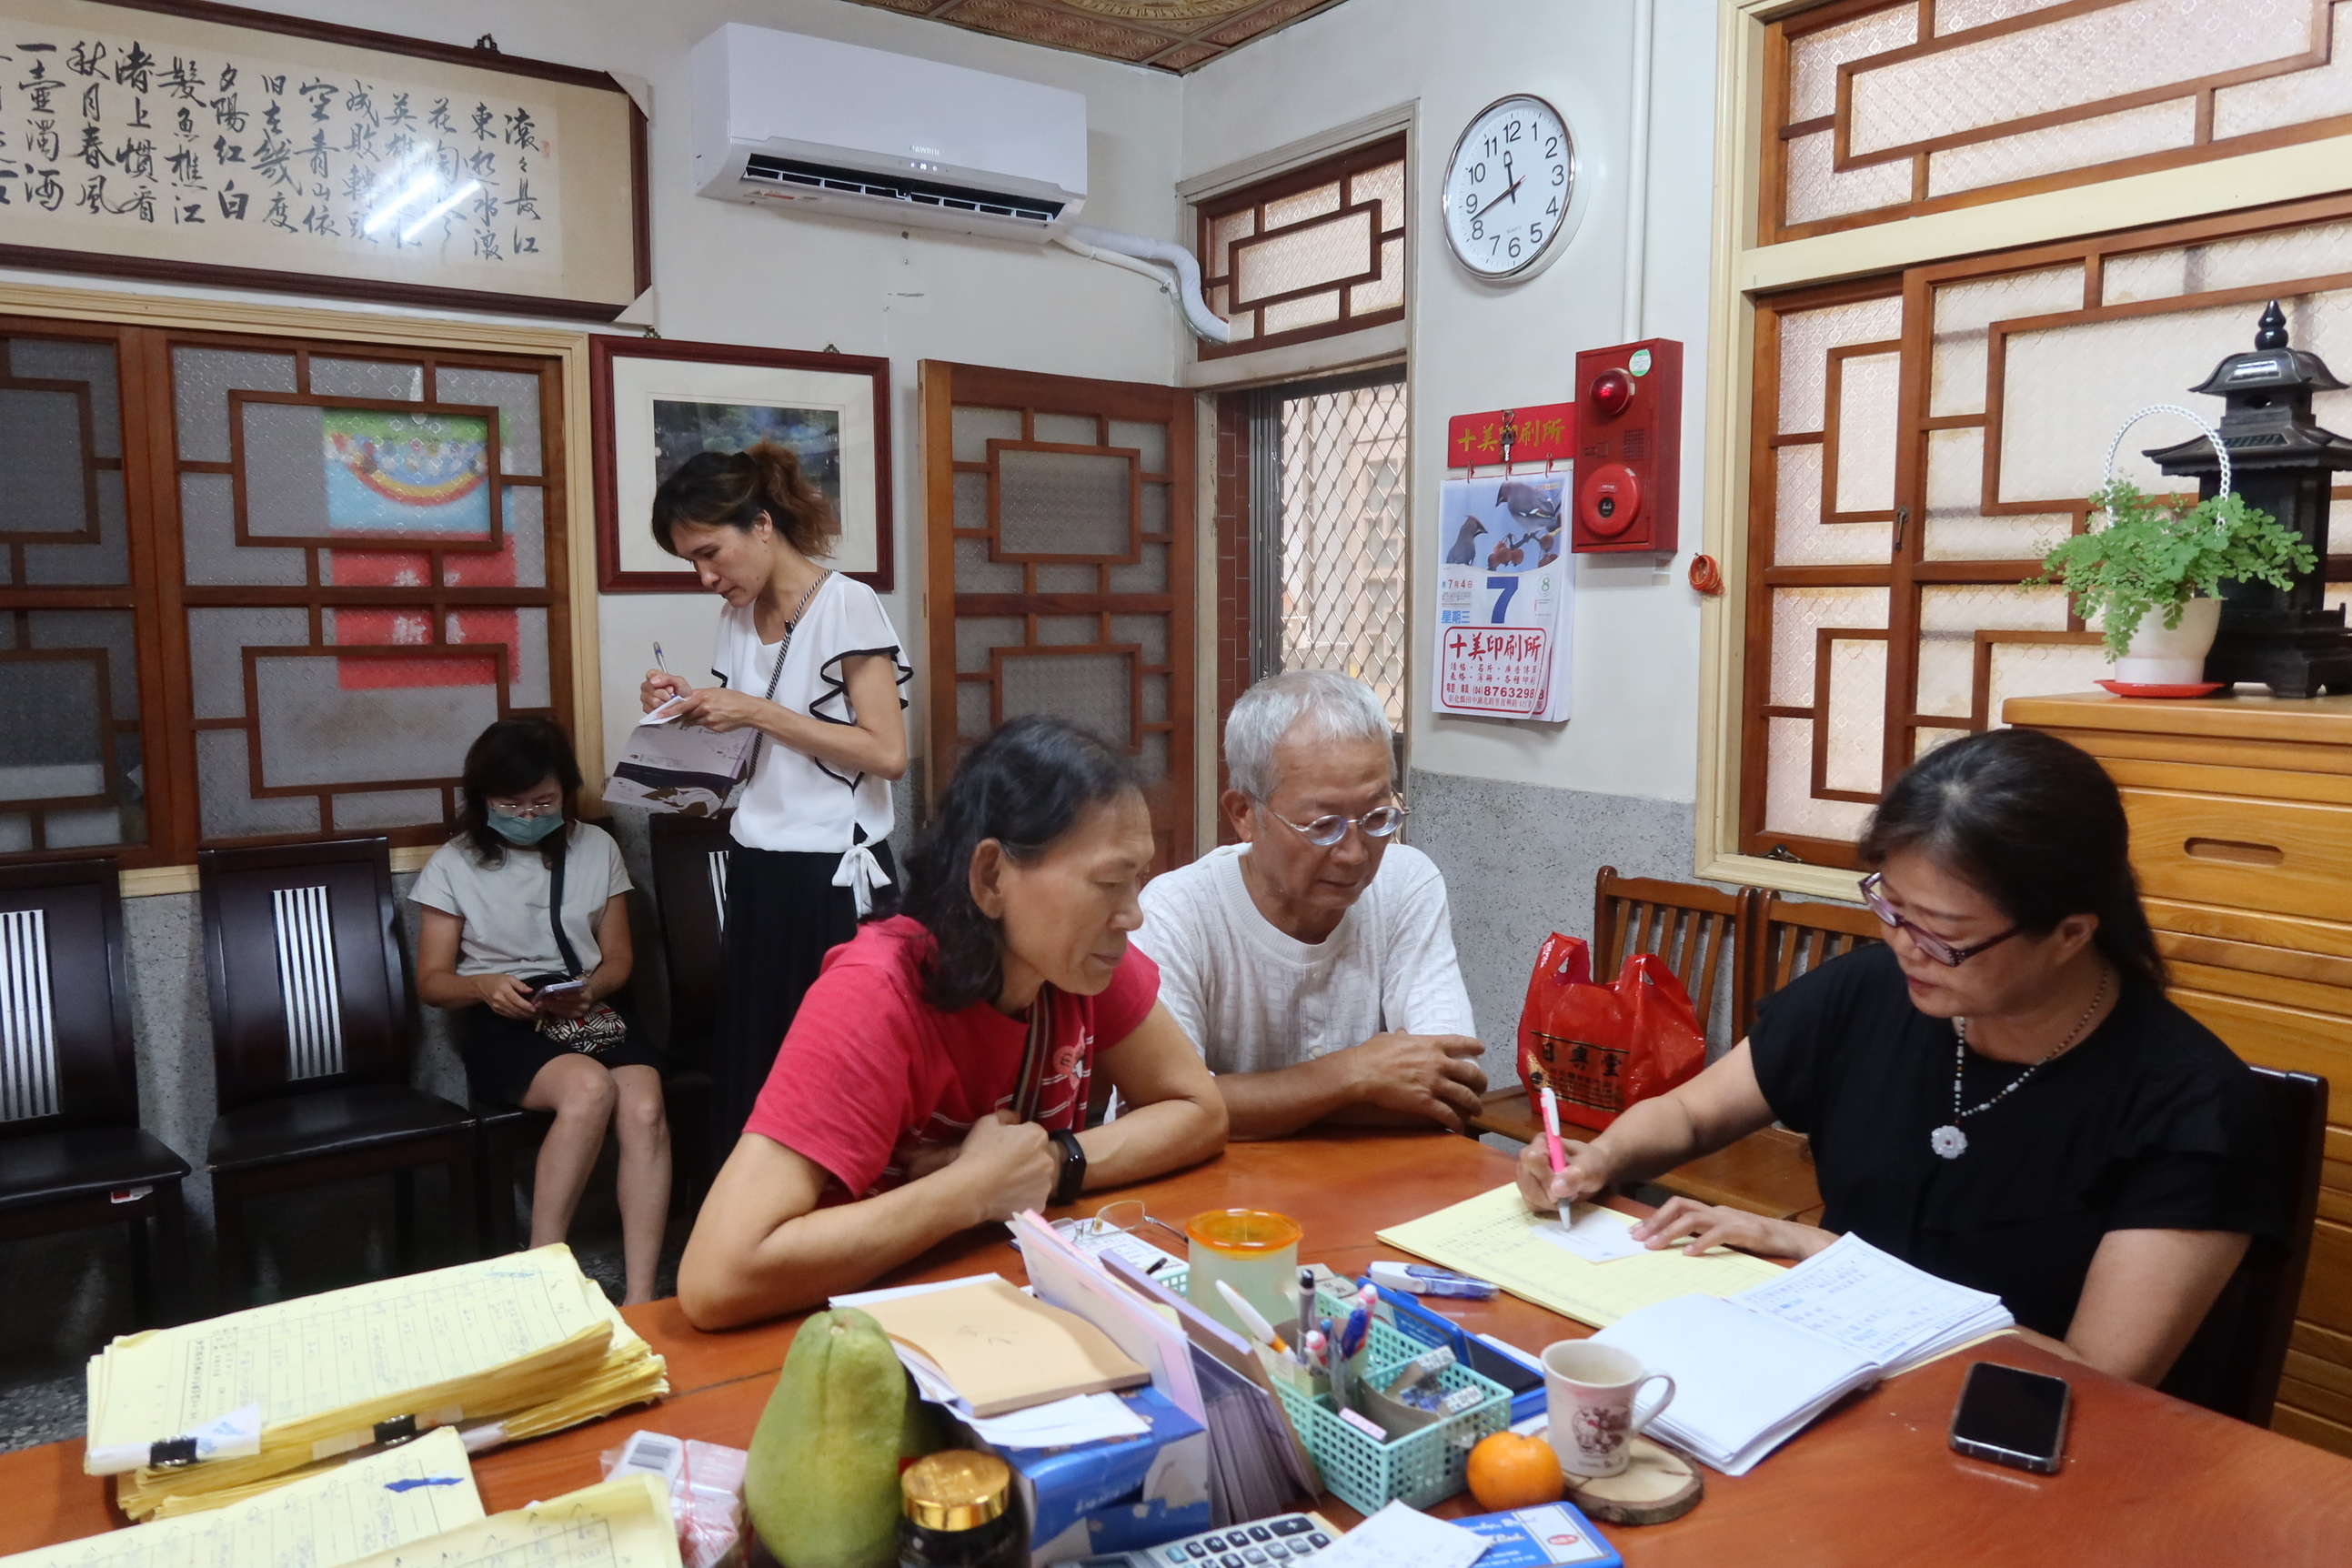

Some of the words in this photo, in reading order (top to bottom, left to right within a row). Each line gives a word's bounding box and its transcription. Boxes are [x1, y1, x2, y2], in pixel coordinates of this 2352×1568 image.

[1503, 120, 1522, 144] 12
[1531, 121, 1538, 141] 1
[1483, 136, 1499, 158] 11
[1544, 136, 1558, 159] 2
[1467, 162, 1486, 186] 10
[1551, 164, 1564, 186] 3
[1465, 193, 1478, 214] 9
[1545, 196, 1559, 217] 4
[1472, 219, 1484, 240] 8
[1530, 222, 1543, 244] 5
[1489, 235, 1501, 256] 7
[1508, 237, 1521, 258] 6
[1448, 578, 1473, 589] 7月4日
[1541, 577, 1551, 592] 8
[1486, 576, 1519, 624] 7
[1441, 610, 1471, 624] 星期三
[1449, 632, 1543, 663] 十美印刷所
